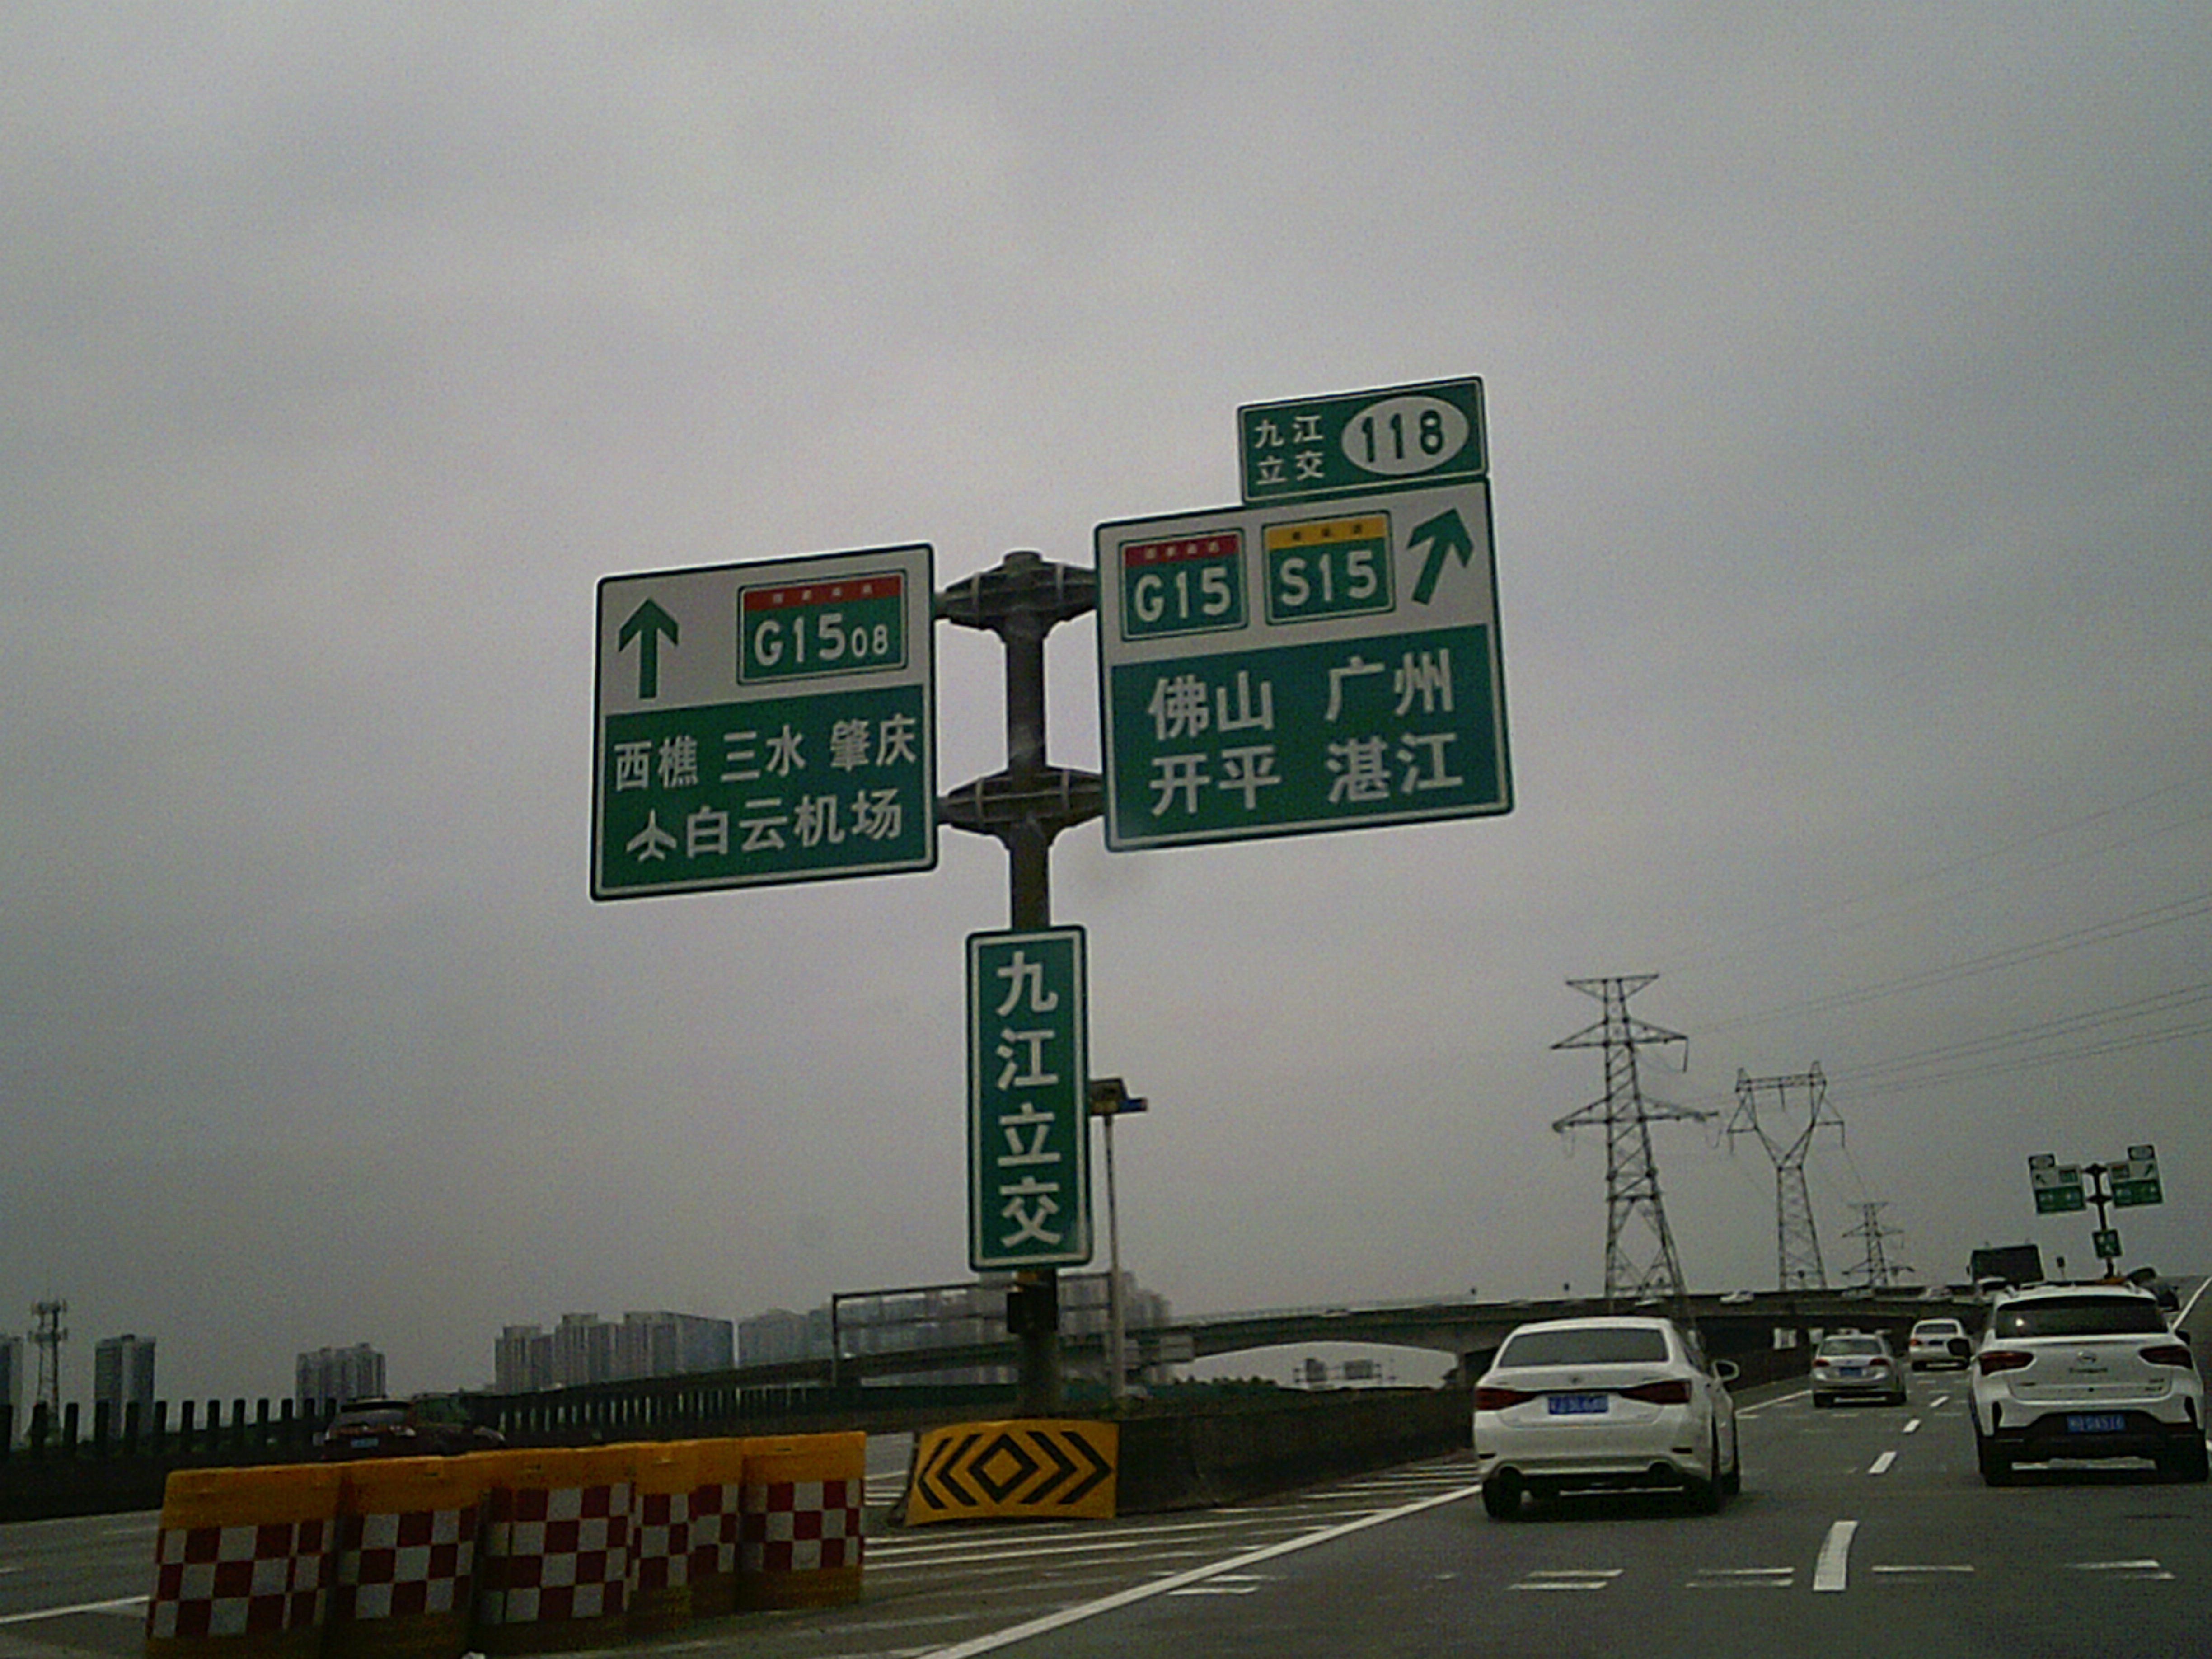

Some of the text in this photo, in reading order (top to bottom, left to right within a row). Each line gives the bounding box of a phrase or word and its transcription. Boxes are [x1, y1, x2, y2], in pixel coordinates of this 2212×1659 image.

[1254, 410, 1443, 462] 九江 118
[1256, 451, 1324, 487] 立交
[1135, 566, 1231, 622] G15
[1281, 549, 1378, 607] S15
[754, 613, 888, 666] G1508
[1148, 648, 1453, 740] 佛山 广州
[614, 712, 916, 792] 西樵 三水 肇庆
[1149, 732, 1463, 815] 开平 湛江
[687, 788, 901, 858] 白云机场
[997, 950, 1061, 1248] 九江立交
